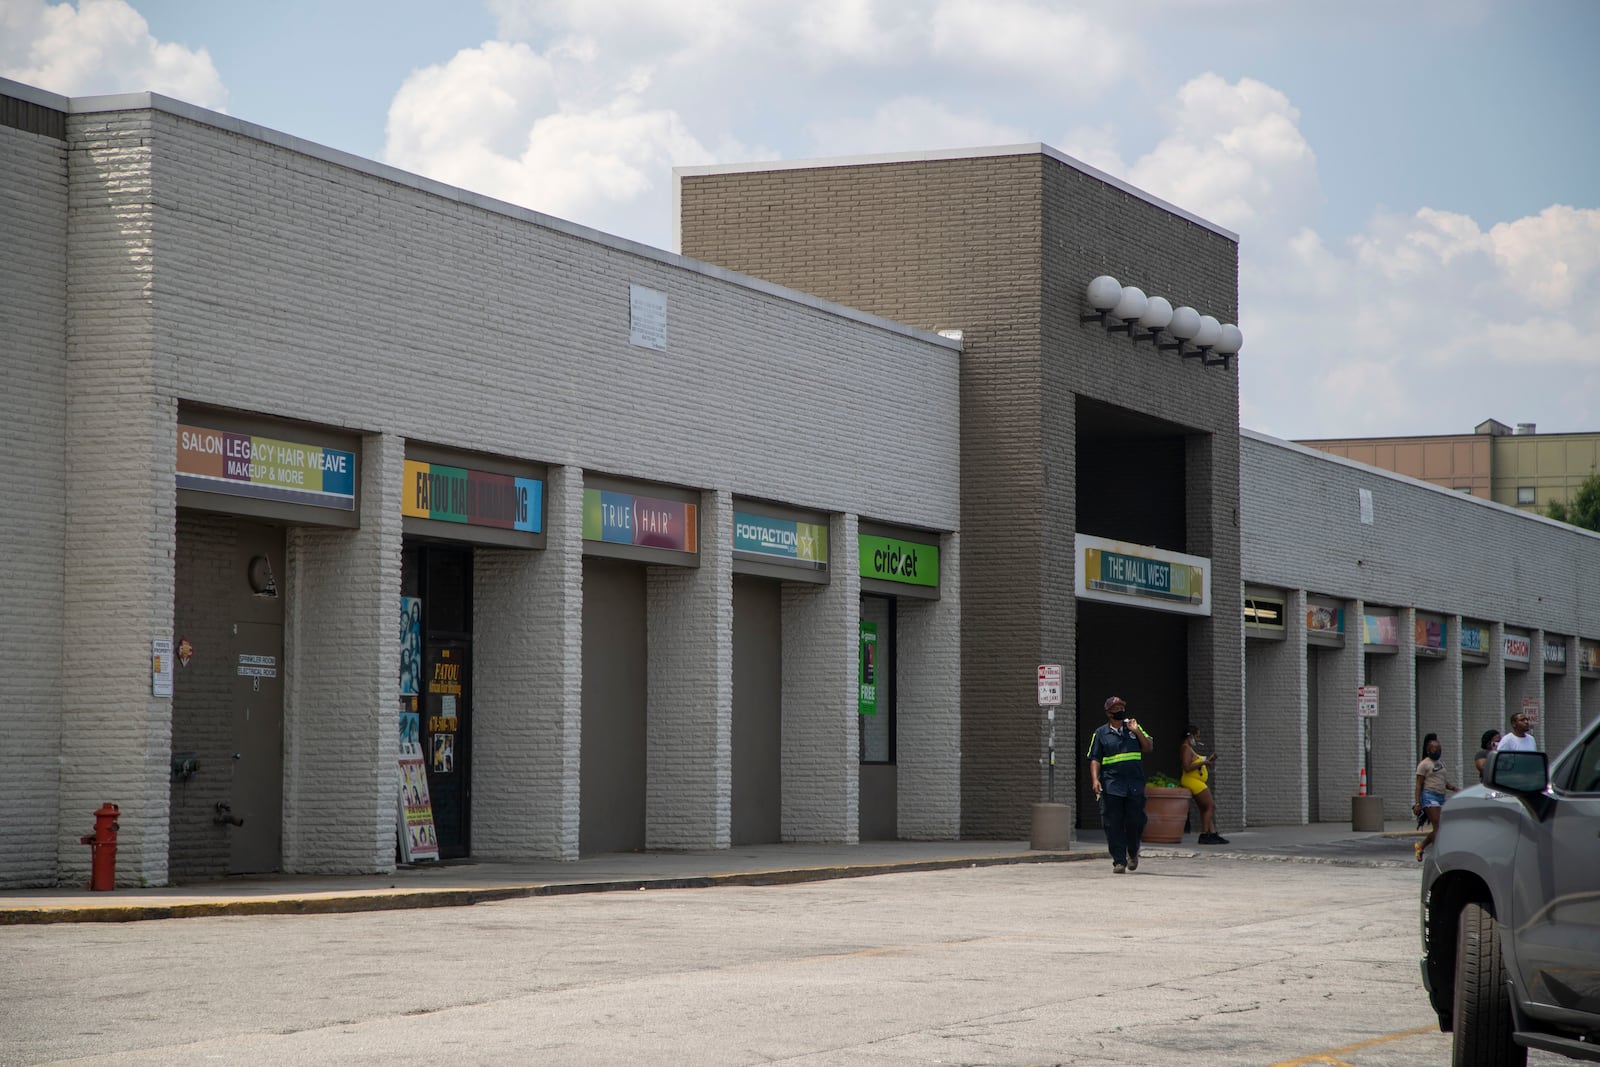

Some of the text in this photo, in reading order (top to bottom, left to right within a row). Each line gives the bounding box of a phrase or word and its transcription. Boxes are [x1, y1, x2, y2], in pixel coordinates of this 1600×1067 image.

[182, 431, 347, 474] SALON LEGACY HAIR WEAVE
[227, 460, 304, 485] MAKEUP & MORE
[416, 471, 449, 513] FATOU
[602, 503, 668, 534] TRUE HAIR
[736, 523, 798, 546] FOOTACTION
[874, 544, 918, 577] cricket
[1108, 556, 1124, 580] THE
[1125, 560, 1147, 584] MALL
[1147, 564, 1169, 588] WEST
[1506, 639, 1529, 657] FASHION
[263, 668, 275, 676] ROOM
[434, 663, 460, 681] FATOU
[861, 686, 875, 701] FREE
[1527, 715, 1539, 723] ANE
